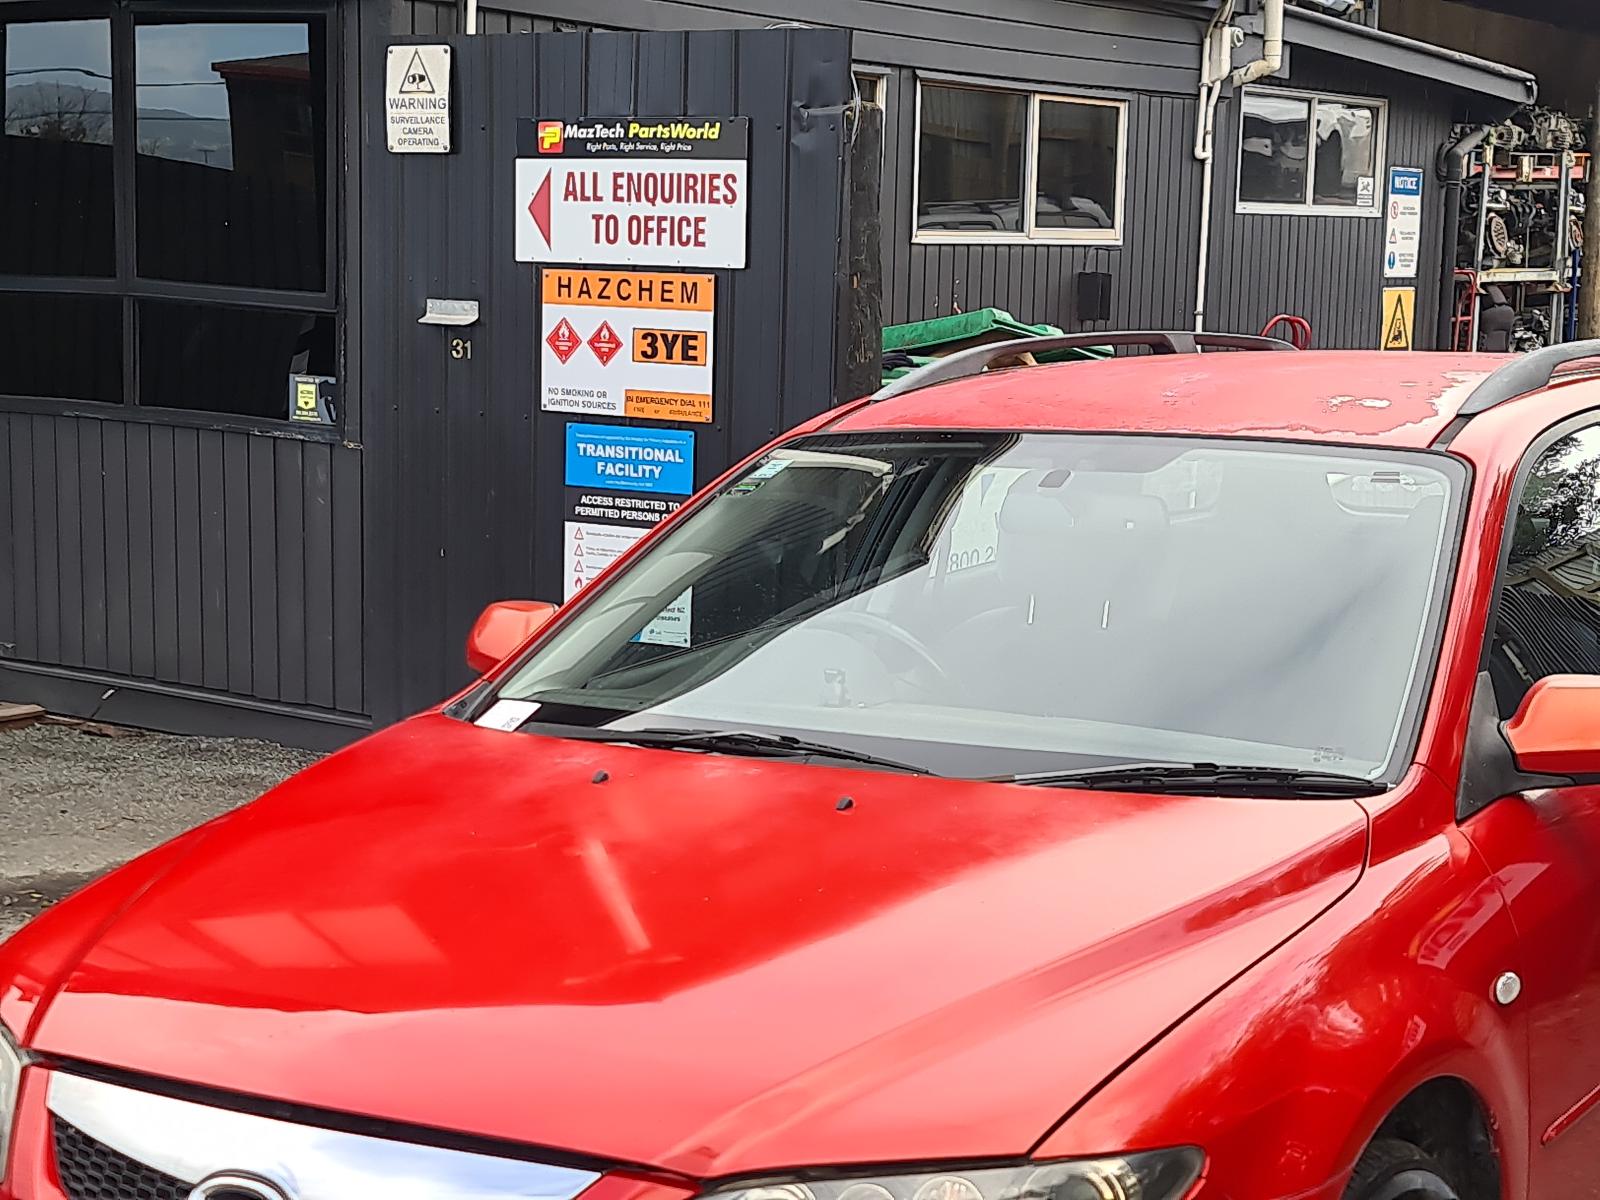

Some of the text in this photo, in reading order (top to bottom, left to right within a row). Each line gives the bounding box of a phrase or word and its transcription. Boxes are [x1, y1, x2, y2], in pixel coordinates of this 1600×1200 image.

[389, 97, 447, 110] WARNING
[390, 116, 446, 125] SURVEILLANCE
[402, 127, 434, 135] CAMERA
[564, 122, 721, 140] MazTech PartsWorld
[397, 137, 440, 146] OPERATING
[563, 171, 737, 205] ALL ENQUIRIES
[591, 213, 707, 248] TO OFFICE
[557, 276, 698, 304] HAZCHEM
[450, 338, 472, 360] 31
[640, 332, 699, 362] 3YE
[548, 387, 608, 399] NO SMOKING OR
[548, 398, 617, 411] IGNITION SOURCES
[635, 396, 679, 407] EMERGENCY
[680, 398, 696, 408] DIAL
[698, 400, 710, 409] 111
[576, 442, 684, 464] TRANSITIONAL
[596, 461, 663, 480] FACILITY
[580, 495, 681, 512] ACCESS RESTRICTED TO
[574, 505, 620, 519] PERMITTED
[620, 509, 661, 522] PERSONS
